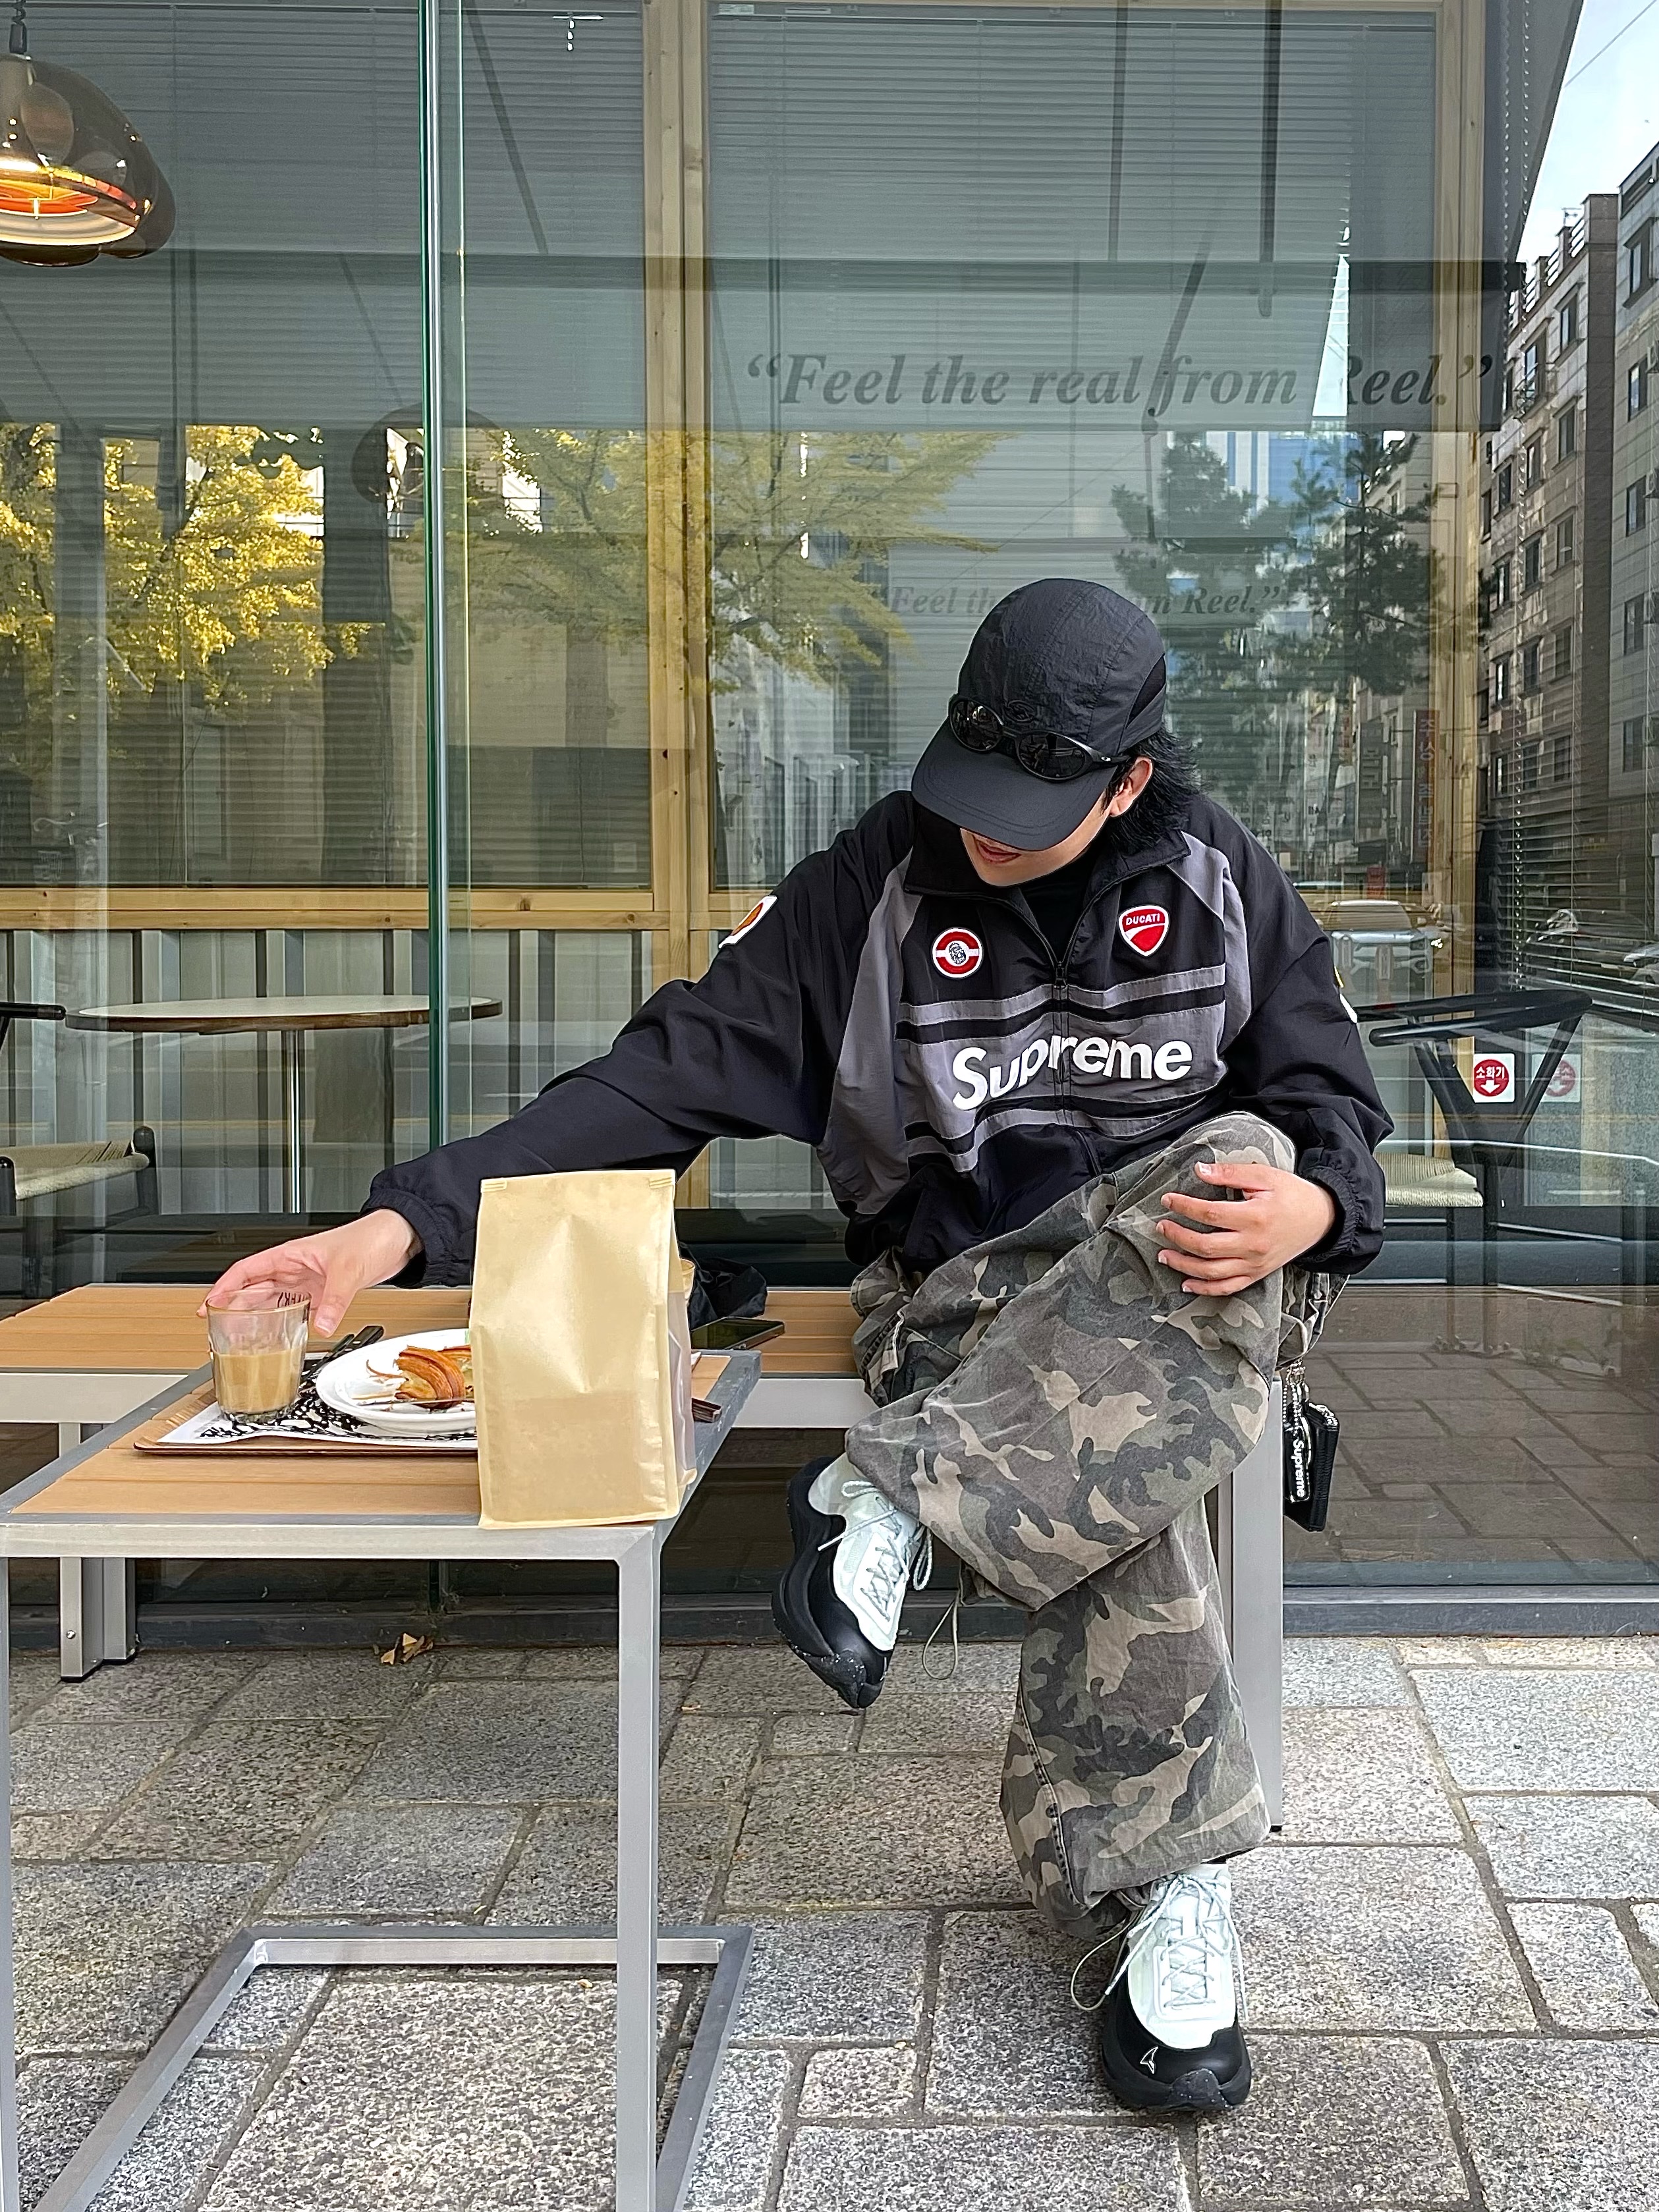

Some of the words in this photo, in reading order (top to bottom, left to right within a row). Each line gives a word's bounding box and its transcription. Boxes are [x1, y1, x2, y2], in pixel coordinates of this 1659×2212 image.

[922, 354, 1010, 405] the
[1029, 355, 1144, 404] real
[1150, 354, 1297, 418] from
[965, 586, 997, 615] th
[1125, 913, 1160, 926] DUCATI
[951, 1035, 1193, 1111] Supreme
[1475, 1066, 1505, 1080] 소화기
[1291, 1439, 1305, 1498] Supreme
